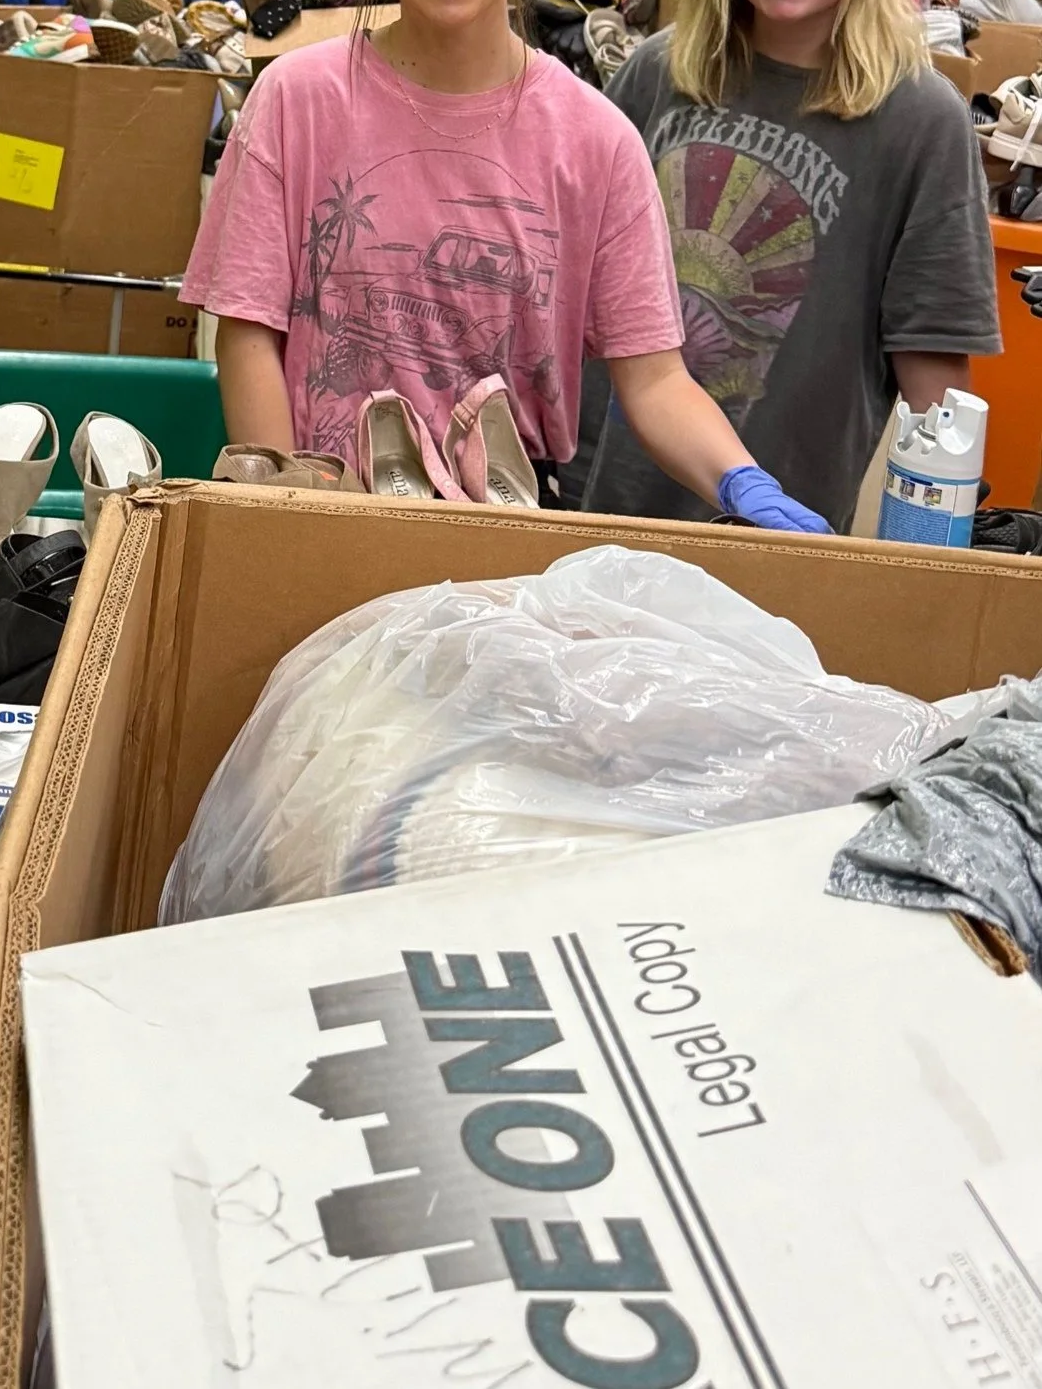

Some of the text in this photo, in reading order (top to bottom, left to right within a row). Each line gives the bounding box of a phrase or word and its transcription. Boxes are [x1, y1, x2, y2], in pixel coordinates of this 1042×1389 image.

[165, 315, 188, 329] DO
[615, 921, 767, 1138] Legal Copy
